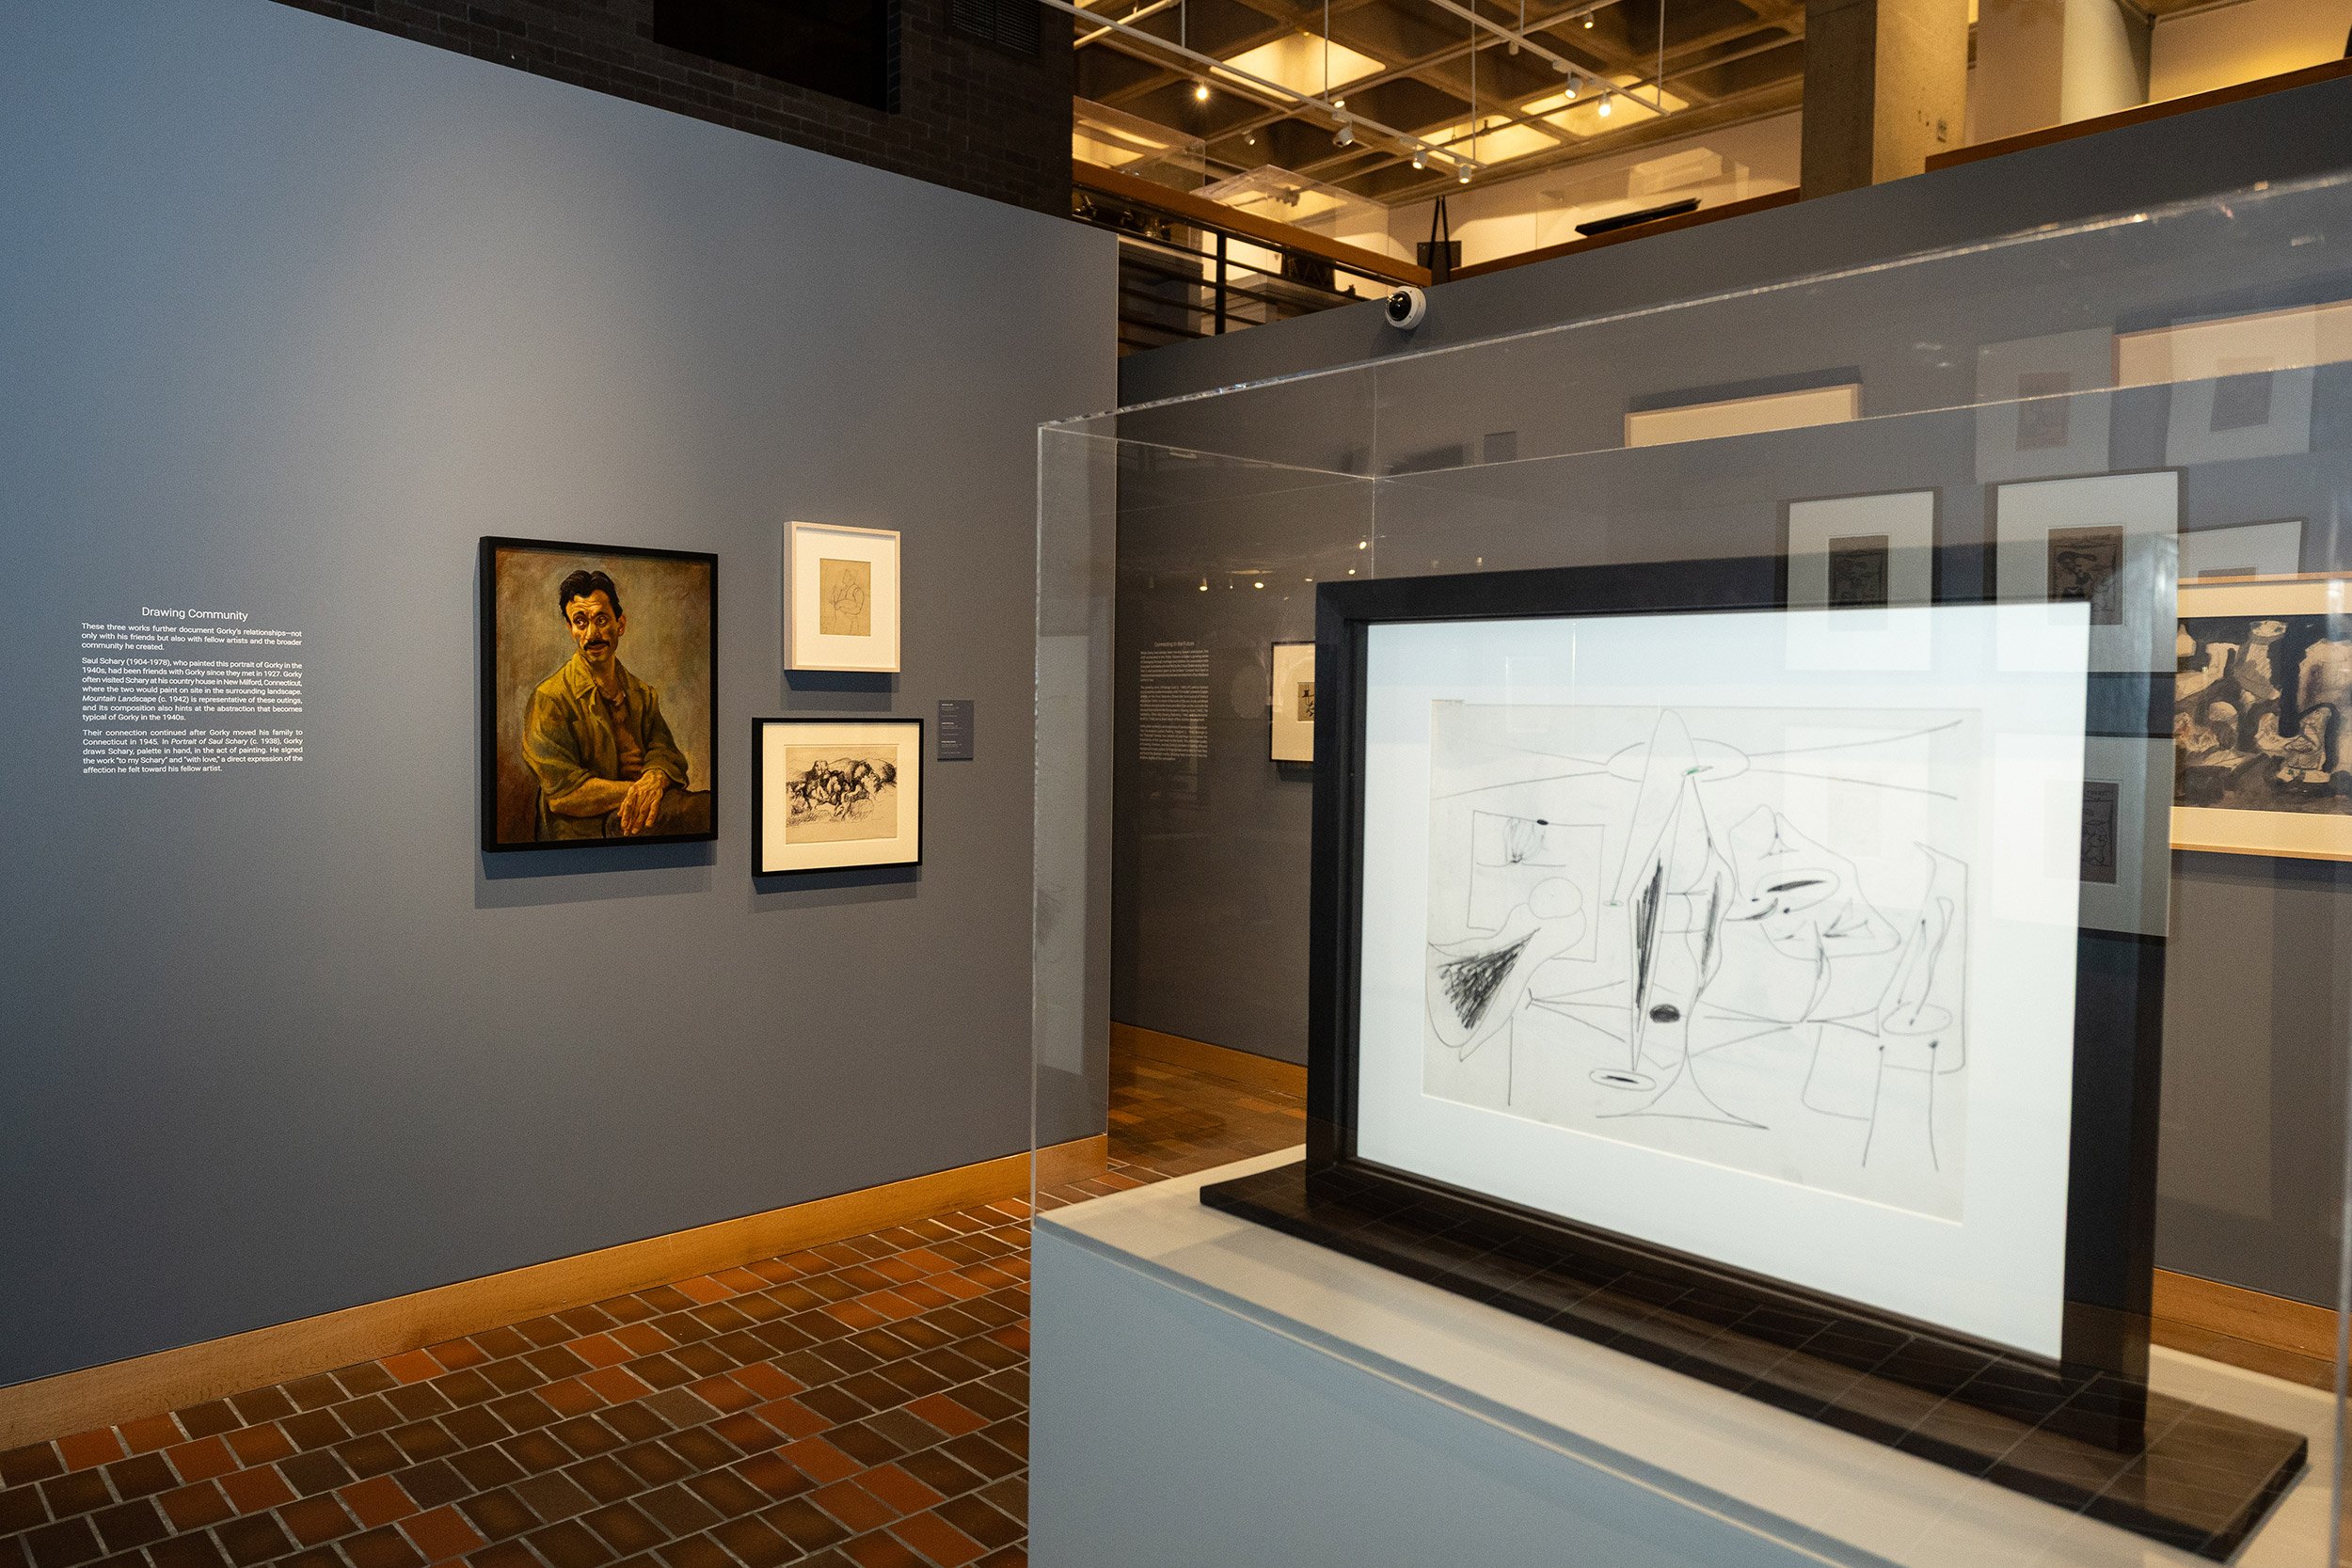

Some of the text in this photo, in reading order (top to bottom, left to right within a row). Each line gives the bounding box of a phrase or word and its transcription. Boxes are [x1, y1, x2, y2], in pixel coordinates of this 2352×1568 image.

[142, 607, 248, 622] Drawing Community
[179, 626, 214, 634] document
[81, 632, 97, 641] only
[81, 641, 123, 651] community
[99, 657, 125, 667] Schary
[189, 659, 215, 669] painted
[230, 660, 254, 669] portrait
[264, 661, 283, 670] Gorky
[185, 668, 205, 677] Gorky
[226, 669, 240, 678] they
[283, 670, 302, 679] Gorky
[125, 676, 149, 686] Schary
[169, 677, 194, 686] country
[159, 686, 177, 695] paint
[225, 686, 265, 696] surrounding
[118, 695, 156, 704] Landscape
[170, 695, 189, 704] 1942)
[198, 696, 246, 705] representative
[110, 704, 155, 713] composition
[82, 713, 107, 722] typical
[118, 713, 139, 722] Gorky
[209, 728, 230, 737] Gorky
[272, 728, 293, 737] family
[225, 737, 248, 746] Schary
[283, 737, 303, 746] Gorky
[136, 747, 162, 756] palette
[281, 746, 303, 755] signed
[247, 754, 282, 764] expression
